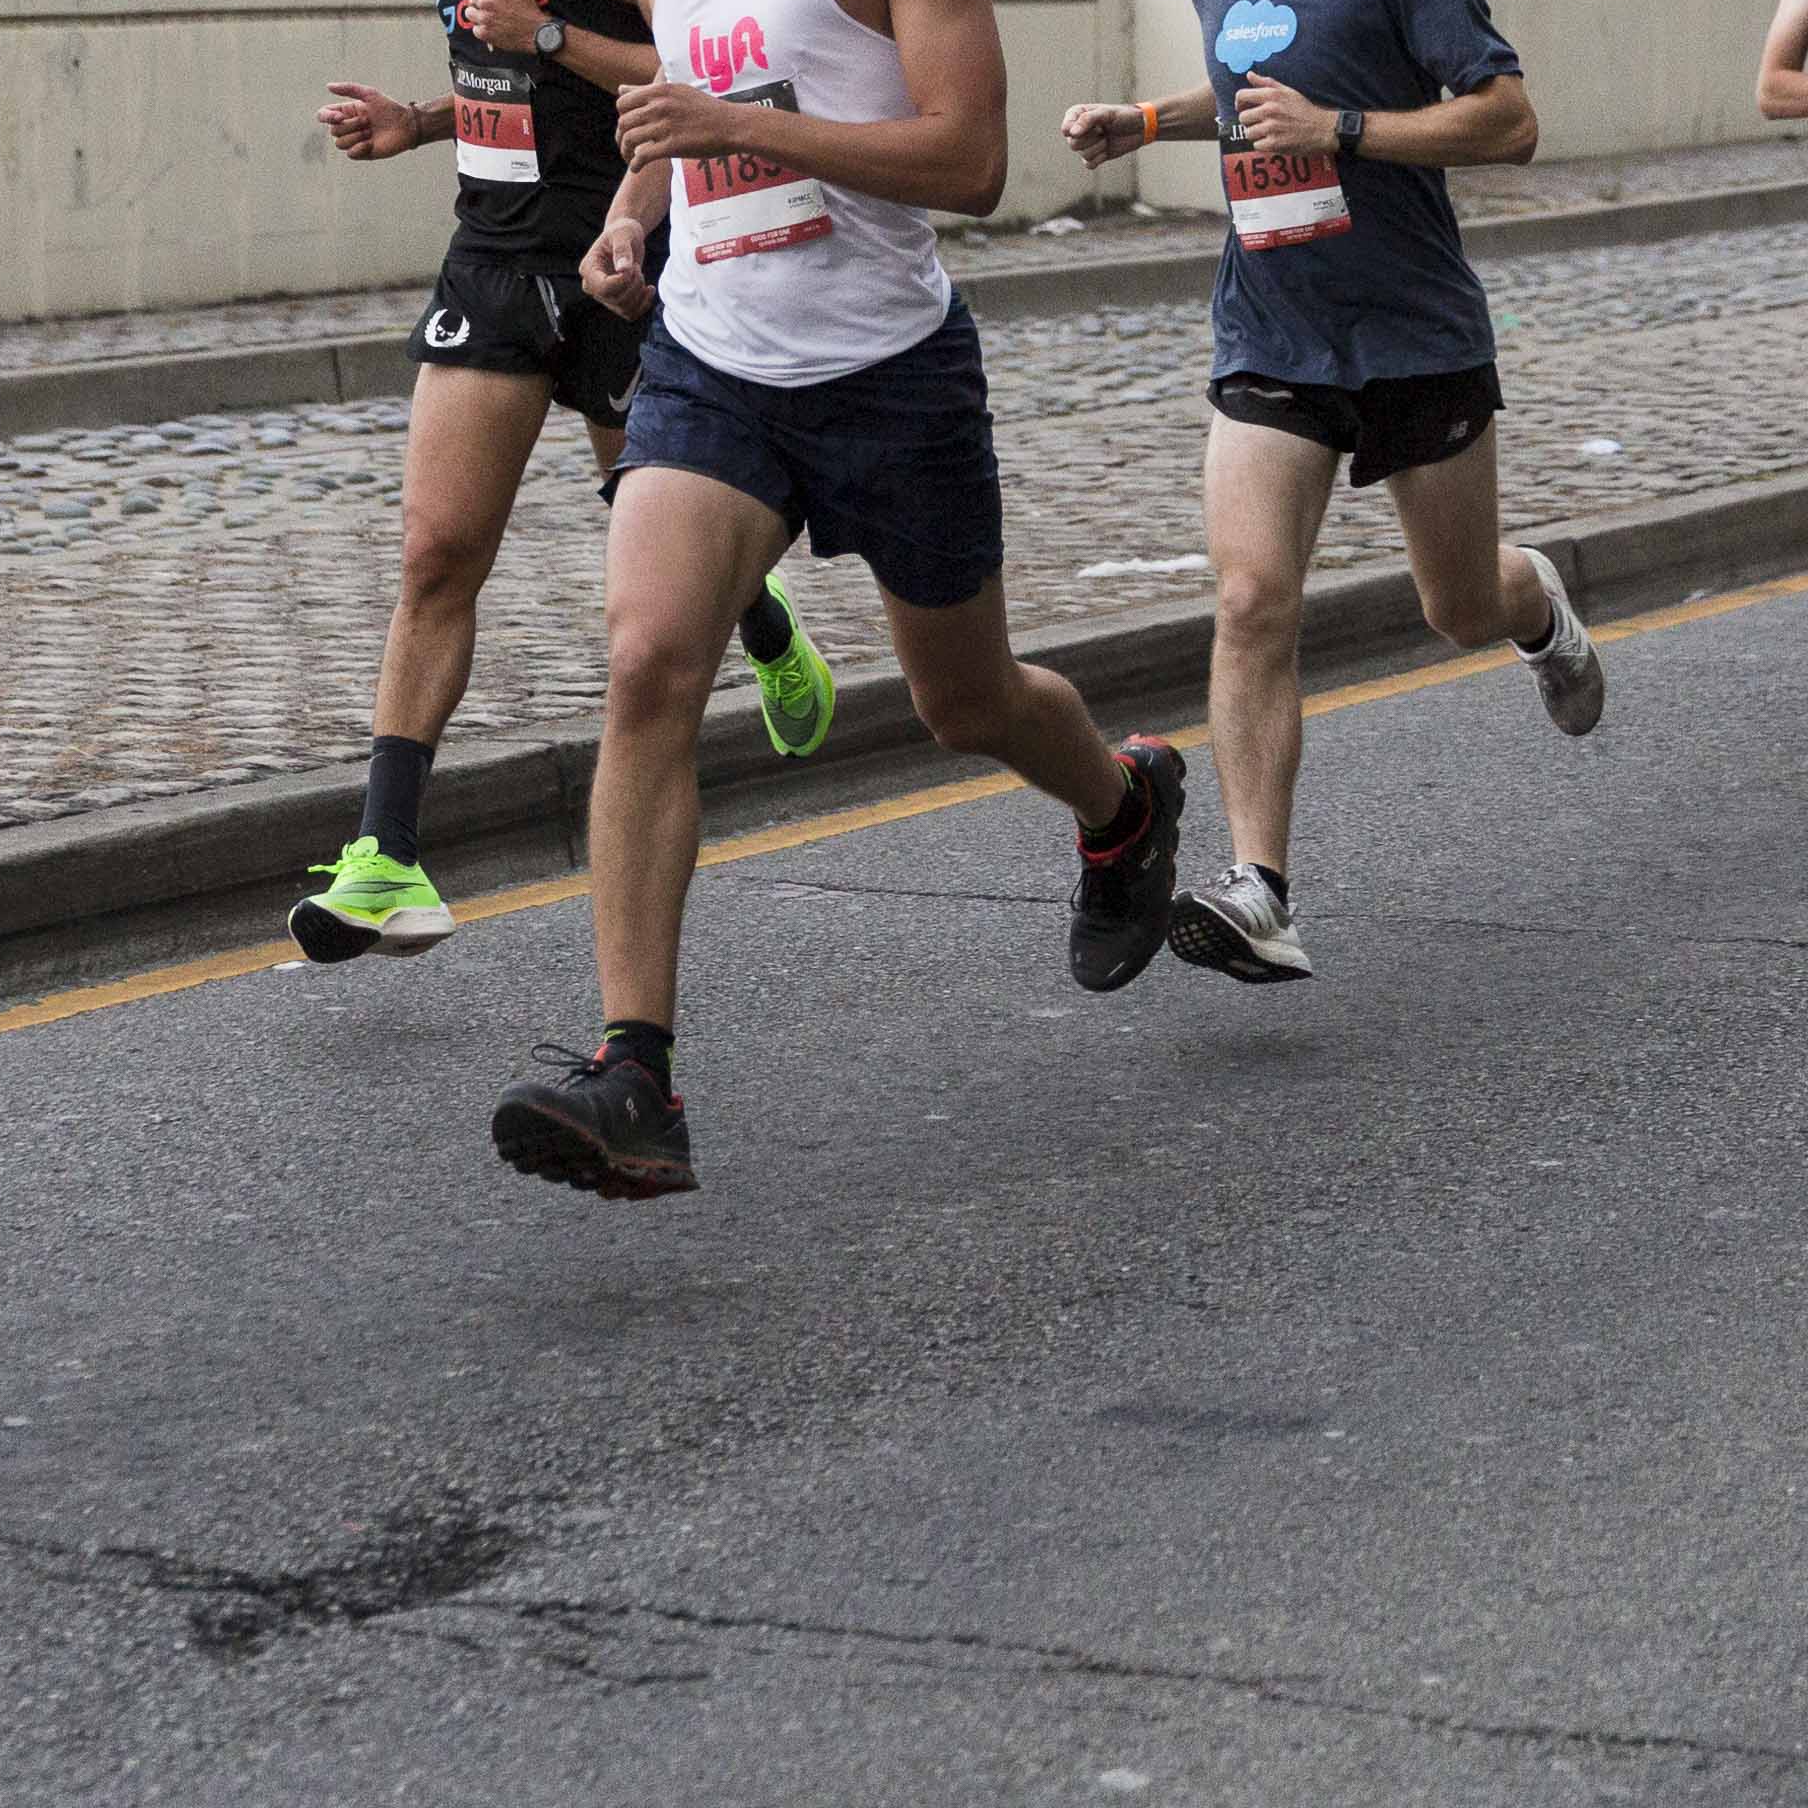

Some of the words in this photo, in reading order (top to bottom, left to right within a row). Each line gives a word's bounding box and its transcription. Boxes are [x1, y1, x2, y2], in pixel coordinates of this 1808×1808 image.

[1226, 21, 1289, 42] salesforce
[689, 16, 769, 93] lyft
[460, 103, 502, 140] 917
[1234, 154, 1313, 193] 1530
